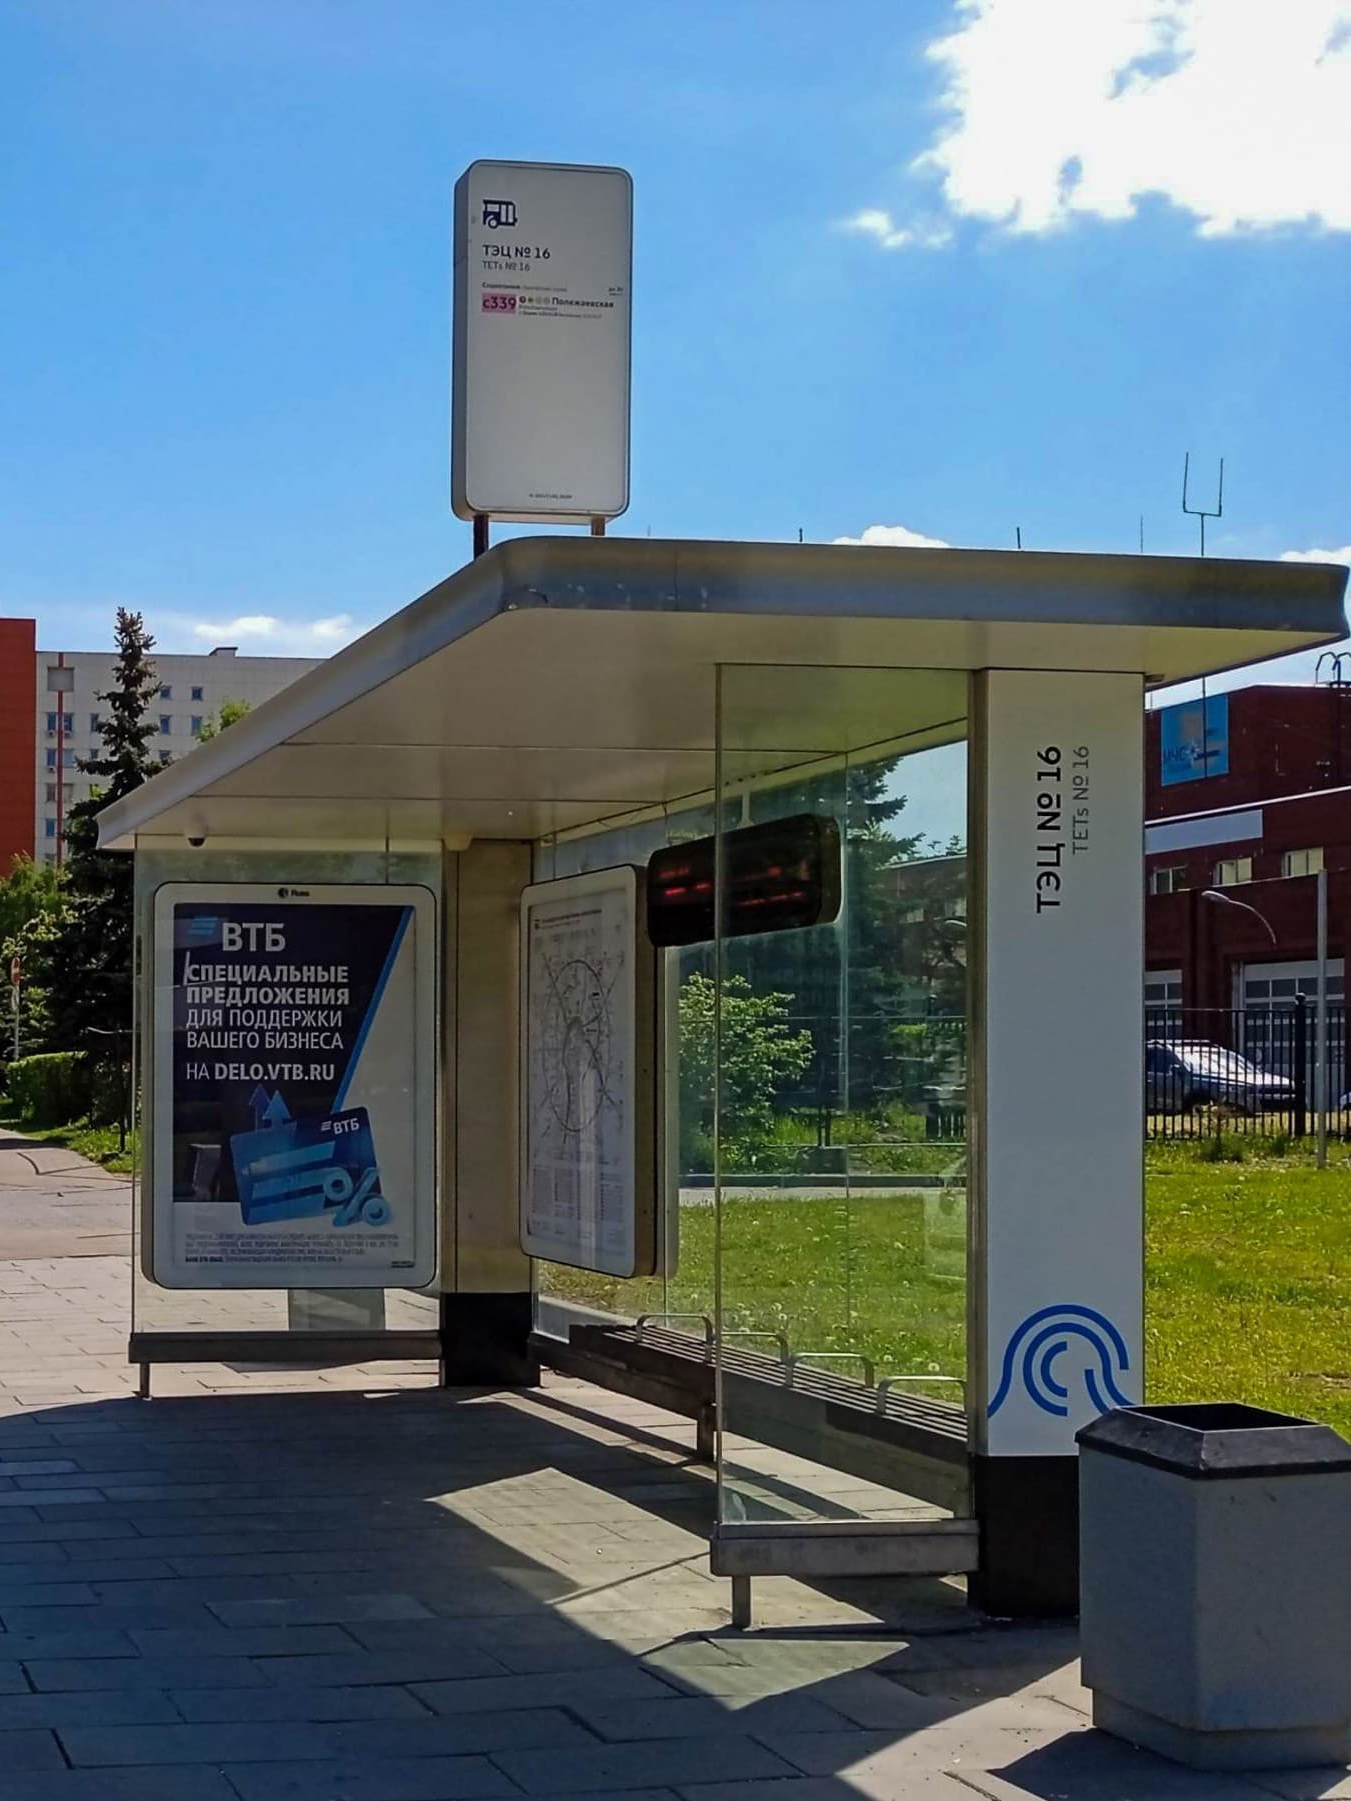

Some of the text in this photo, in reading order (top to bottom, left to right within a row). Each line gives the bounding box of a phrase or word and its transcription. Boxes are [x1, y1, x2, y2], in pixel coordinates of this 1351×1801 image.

[482, 244, 551, 260] ТЭЦ № 16
[482, 260, 503, 270] TETs
[519, 262, 530, 271] 16
[482, 296, 516, 310] с339
[552, 297, 614, 308] Полежаевская
[1072, 745, 1089, 856] TETs № 16
[1036, 746, 1065, 914] ТЭЦ № 16
[222, 922, 286, 952] ВТБ
[187, 964, 349, 985] СПЕЦИАЛЬНЫЕ
[186, 987, 350, 1007] ПРЕДЛОЖЕНИЯ
[186, 1009, 342, 1030] ДЛЯ ПОДДЕРЖКИ
[186, 1031, 344, 1050] ВАШЕГО БИЗНЕСА
[186, 1063, 335, 1081] НА DELO.VTB.RU
[333, 1118, 360, 1135] ВТБ
